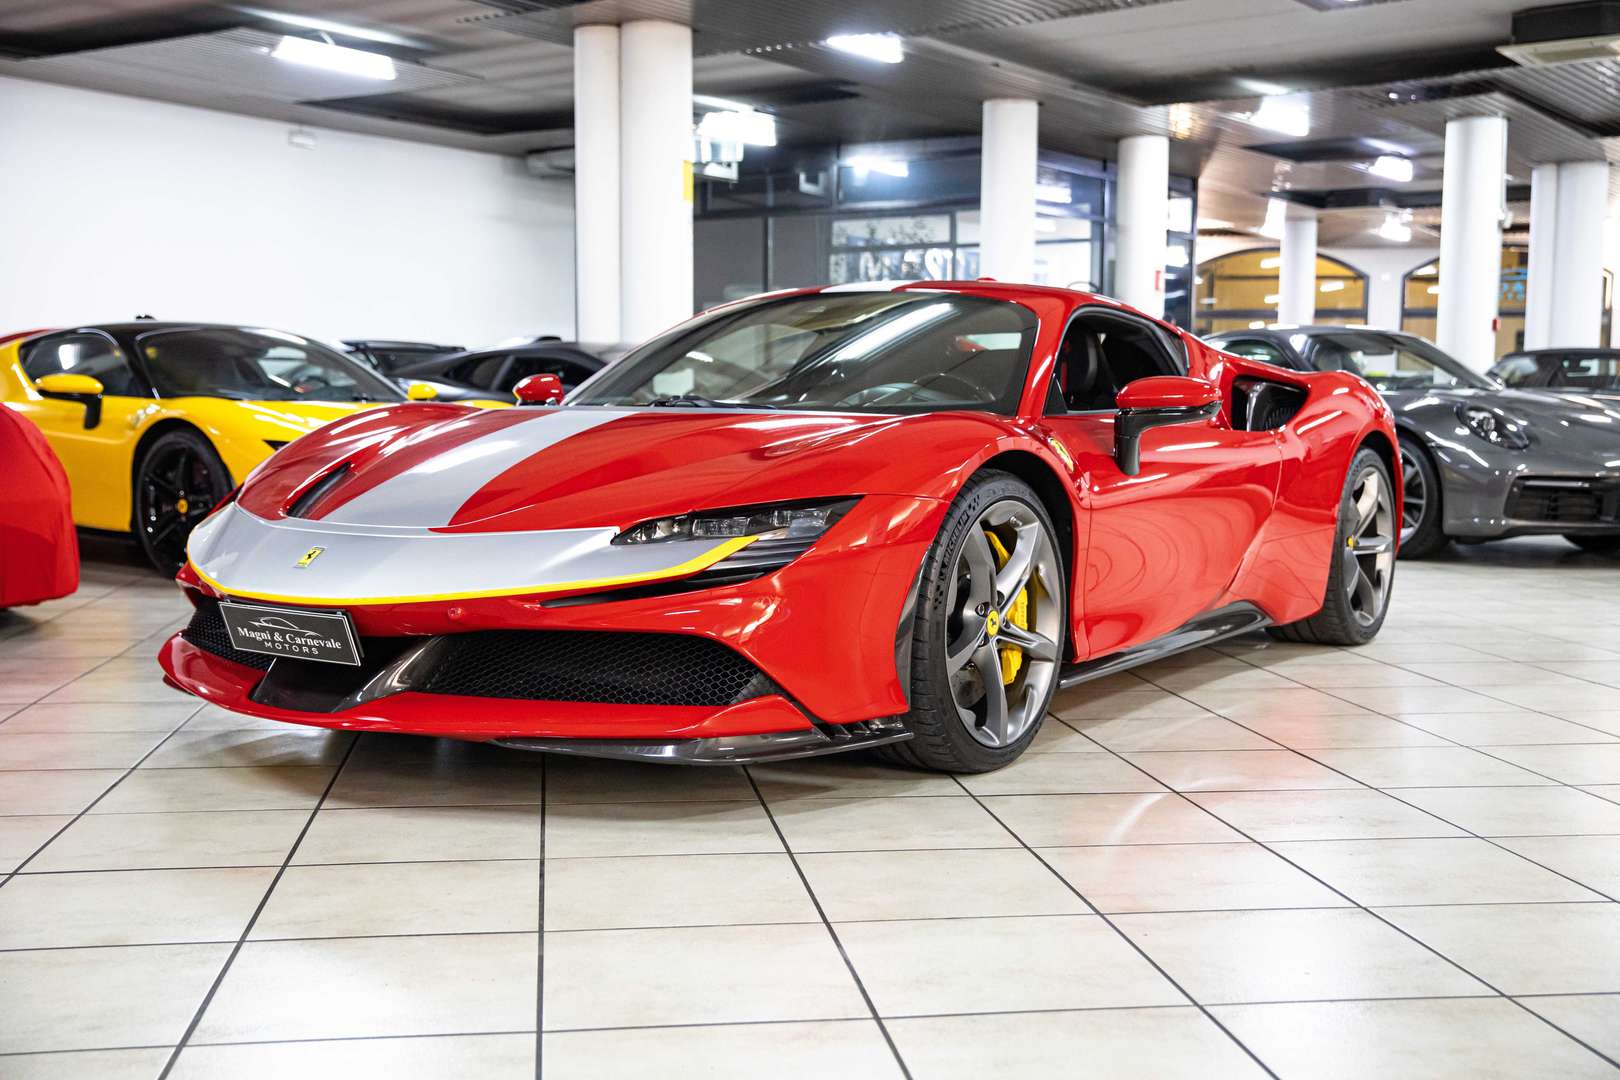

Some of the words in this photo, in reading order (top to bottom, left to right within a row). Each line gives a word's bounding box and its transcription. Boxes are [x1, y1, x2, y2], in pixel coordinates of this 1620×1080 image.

[943, 511, 971, 566] MICHELIN
[237, 627, 271, 642] Magni
[273, 632, 284, 642] &
[286, 633, 342, 649] Carnevale
[264, 641, 319, 655] MOTORS
